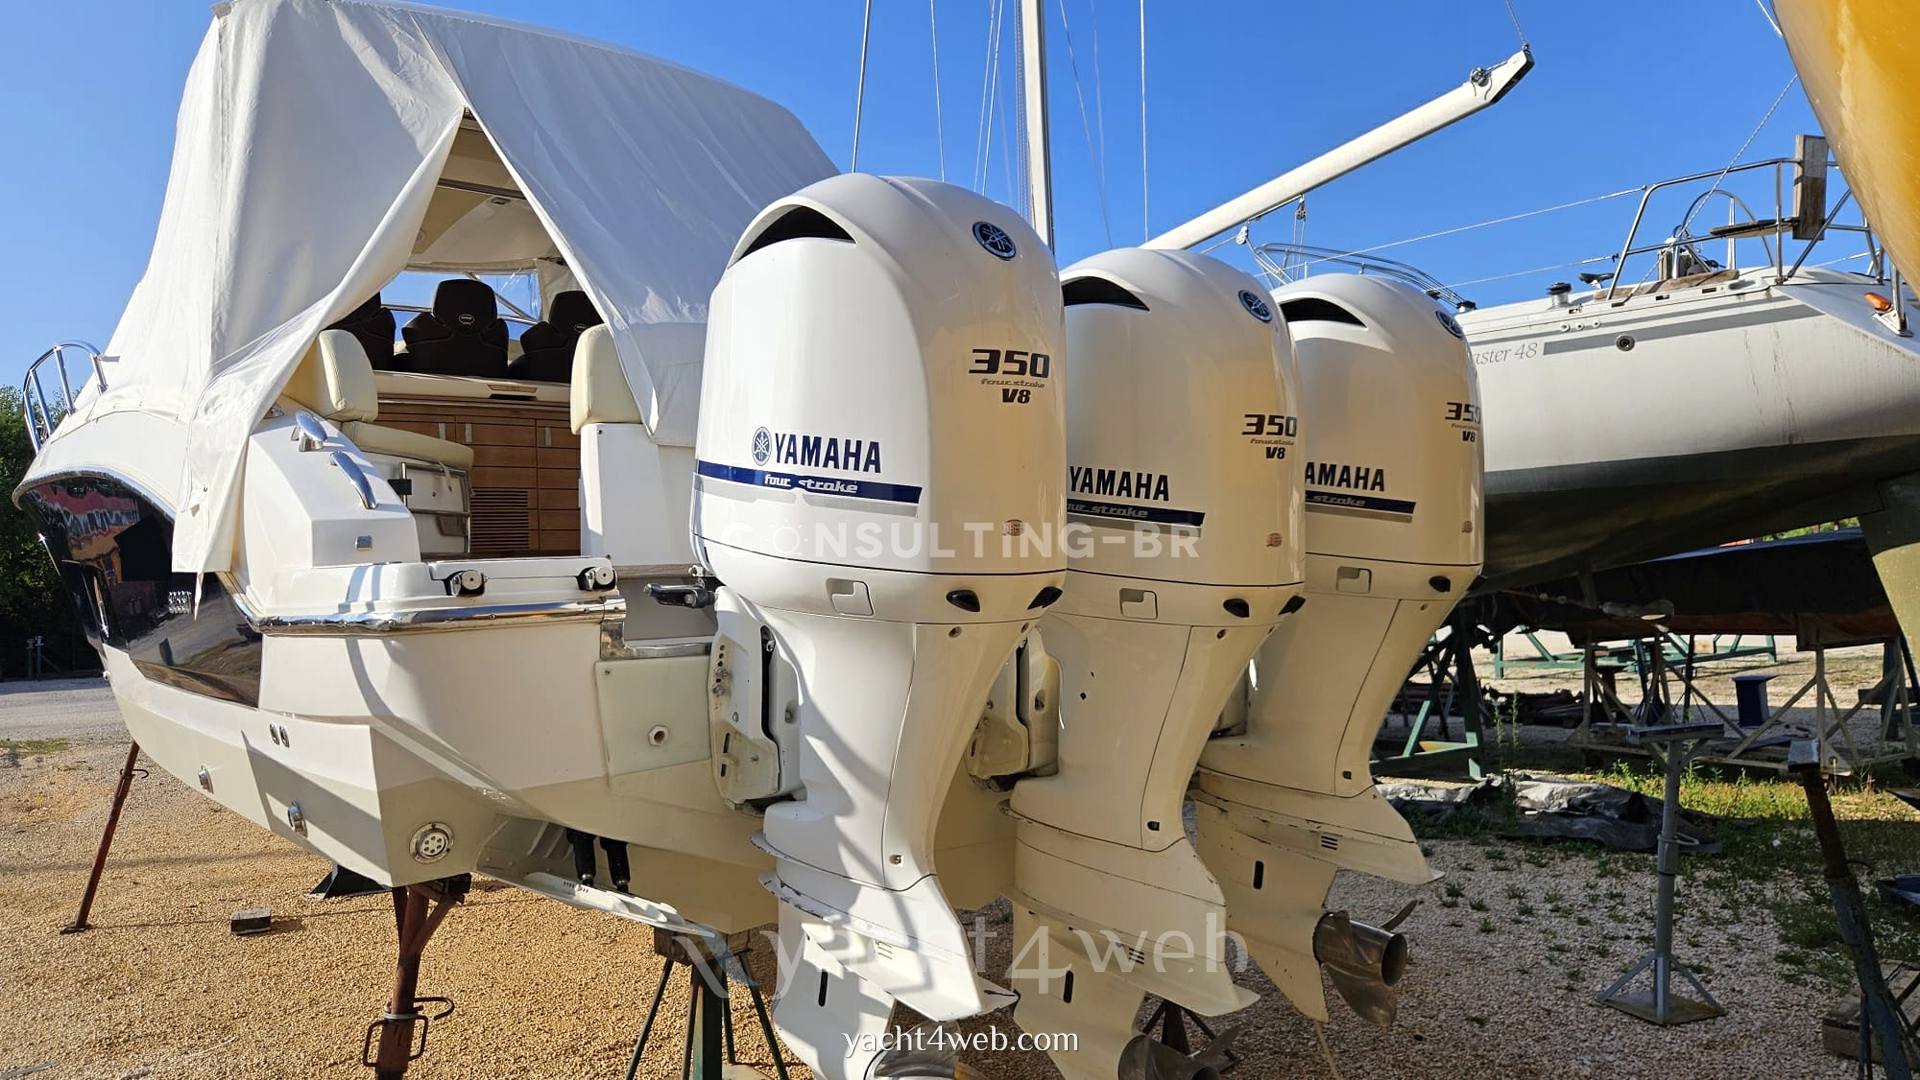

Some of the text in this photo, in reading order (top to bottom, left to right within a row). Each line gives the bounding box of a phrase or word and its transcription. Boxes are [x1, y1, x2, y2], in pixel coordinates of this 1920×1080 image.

[1514, 342, 1538, 359] 48
[968, 349, 1050, 378] 350
[1002, 388, 1031, 404] V8
[1242, 414, 1297, 437] 350
[1462, 431, 1476, 442] V8
[775, 433, 881, 473] YAMAHA
[1266, 446, 1286, 460] V8
[764, 474, 791, 487] four
[1070, 466, 1169, 501] YAMAHA
[1305, 462, 1385, 492] AMAHA
